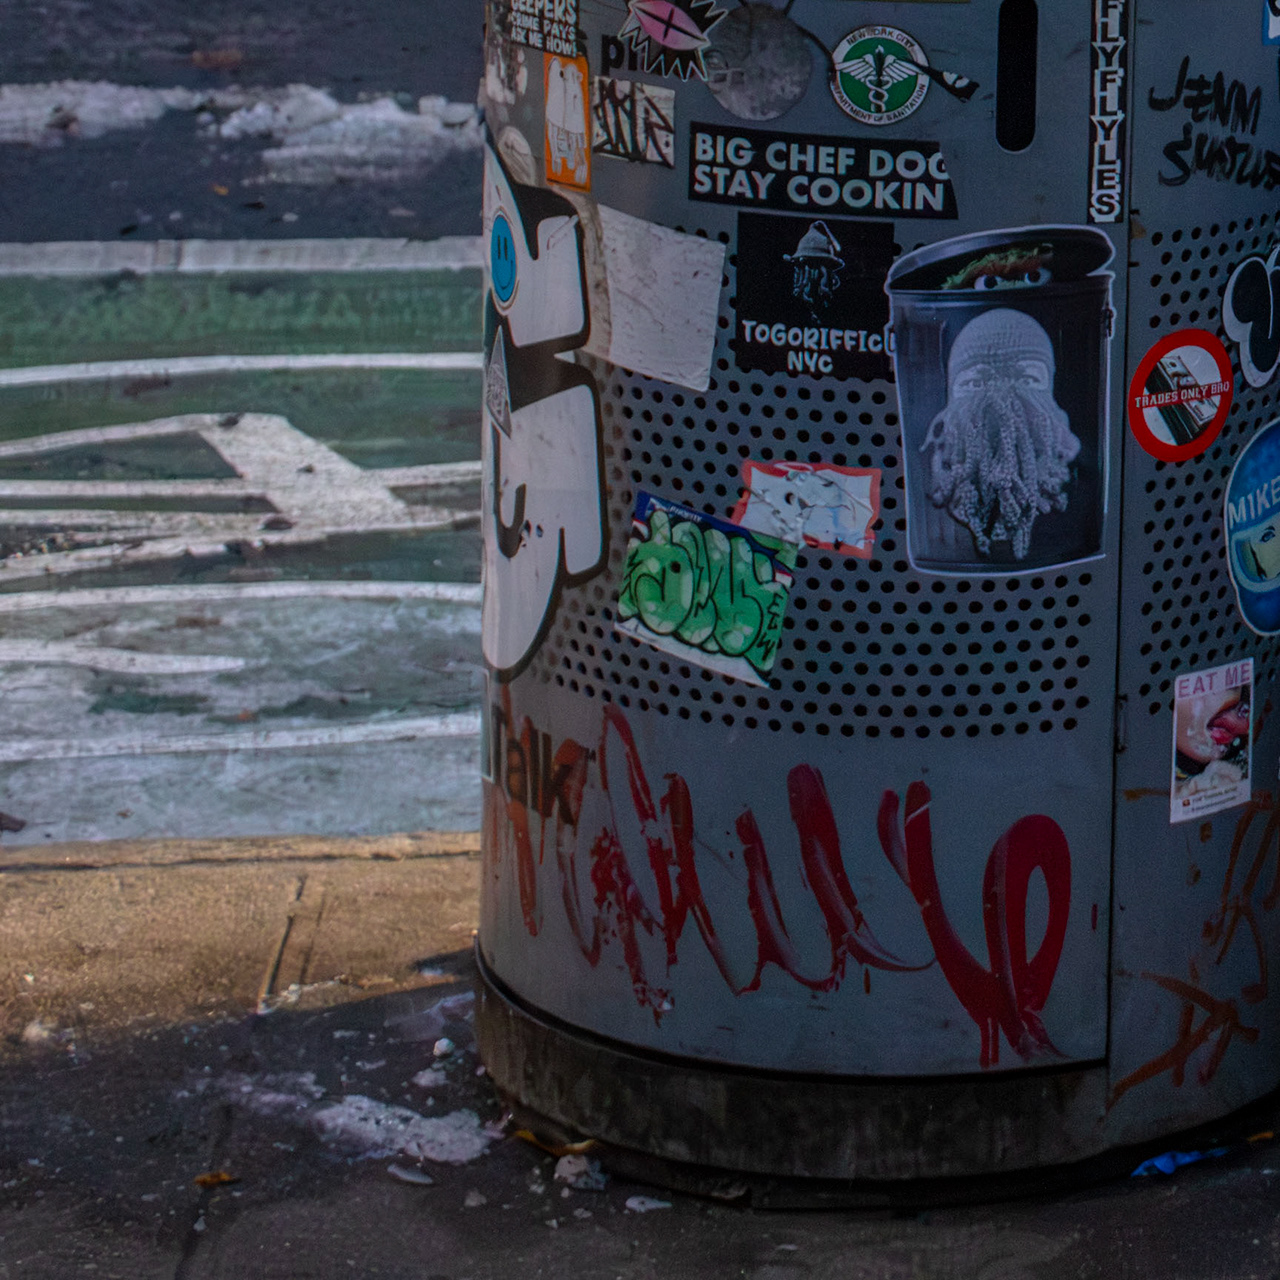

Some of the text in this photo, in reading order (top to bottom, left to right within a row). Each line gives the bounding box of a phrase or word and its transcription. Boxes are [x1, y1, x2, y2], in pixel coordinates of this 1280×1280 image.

[528, 30, 544, 48] ME
[546, 36, 577, 58] HOW!
[543, 19, 577, 41] PAYS
[846, 30, 866, 46] NEW
[694, 131, 758, 167] BIG
[765, 140, 857, 176] CHEF
[693, 163, 945, 212] STAY COOKIN
[741, 319, 884, 353] TOGORIFFIC
[787, 349, 834, 374] NYC
[1134, 380, 1231, 408] TRADES ONLY BRO
[1178, 661, 1251, 699] EAT ME
